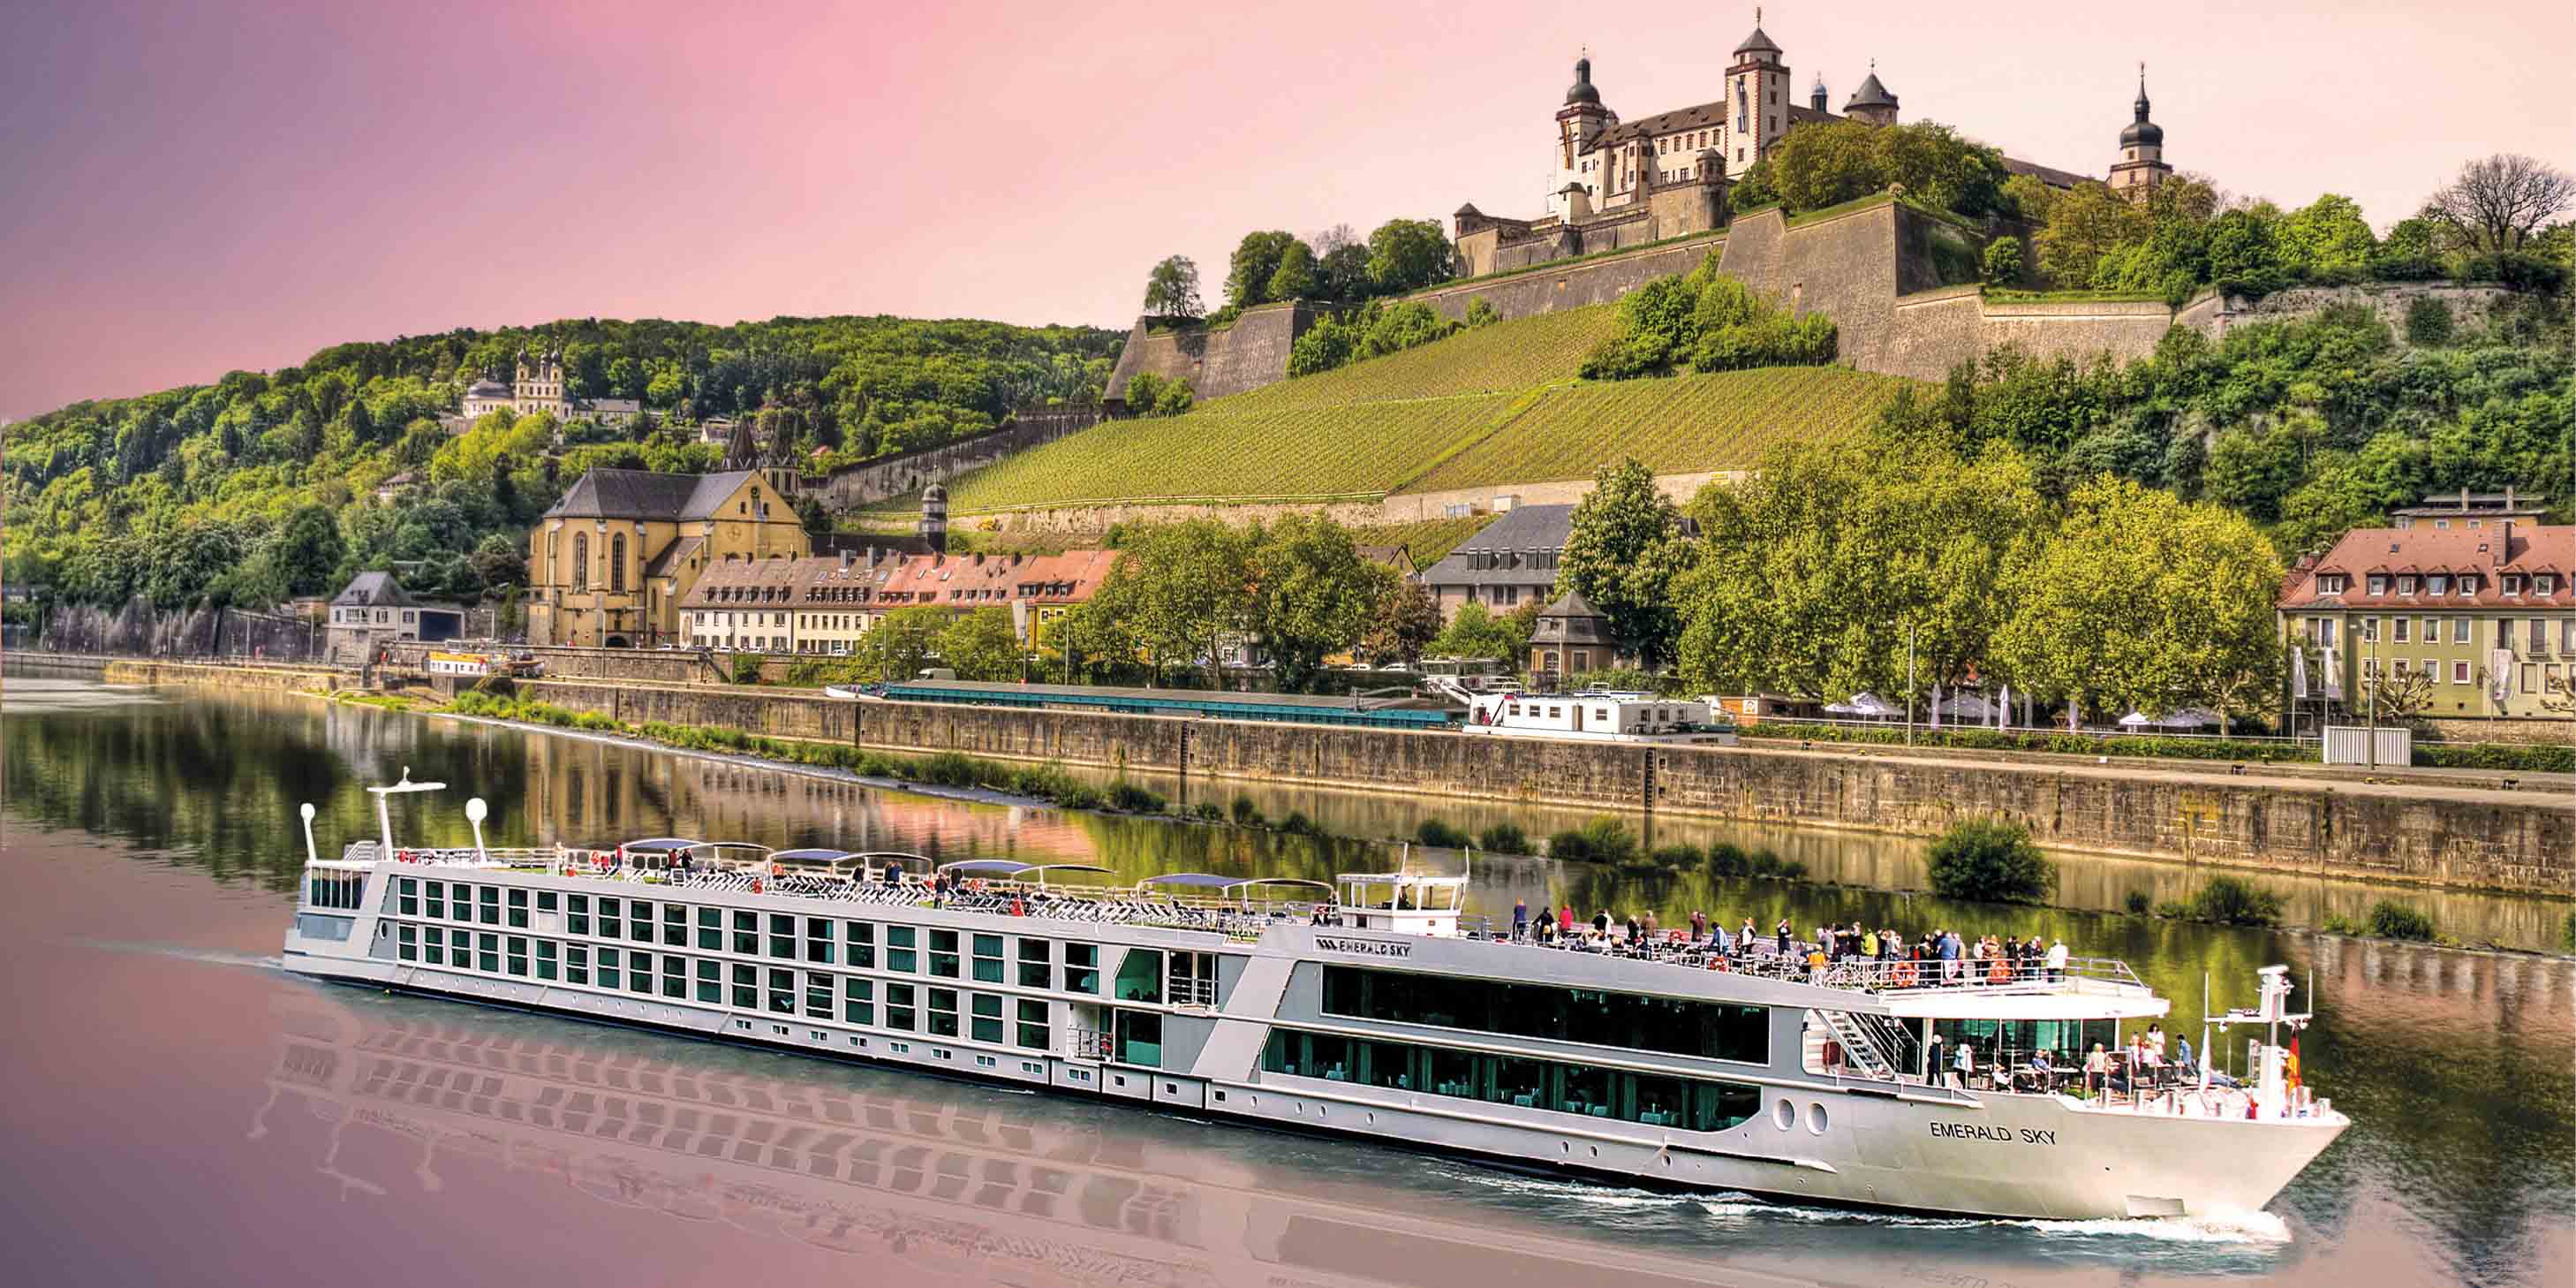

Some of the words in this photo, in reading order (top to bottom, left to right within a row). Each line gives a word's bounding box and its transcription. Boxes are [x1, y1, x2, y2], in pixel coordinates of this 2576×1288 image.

[1339, 940, 1386, 955] EMERALD
[1389, 944, 1411, 957] SKY
[1930, 1122, 2013, 1141] EMERALD
[2020, 1129, 2057, 1146] SKY
